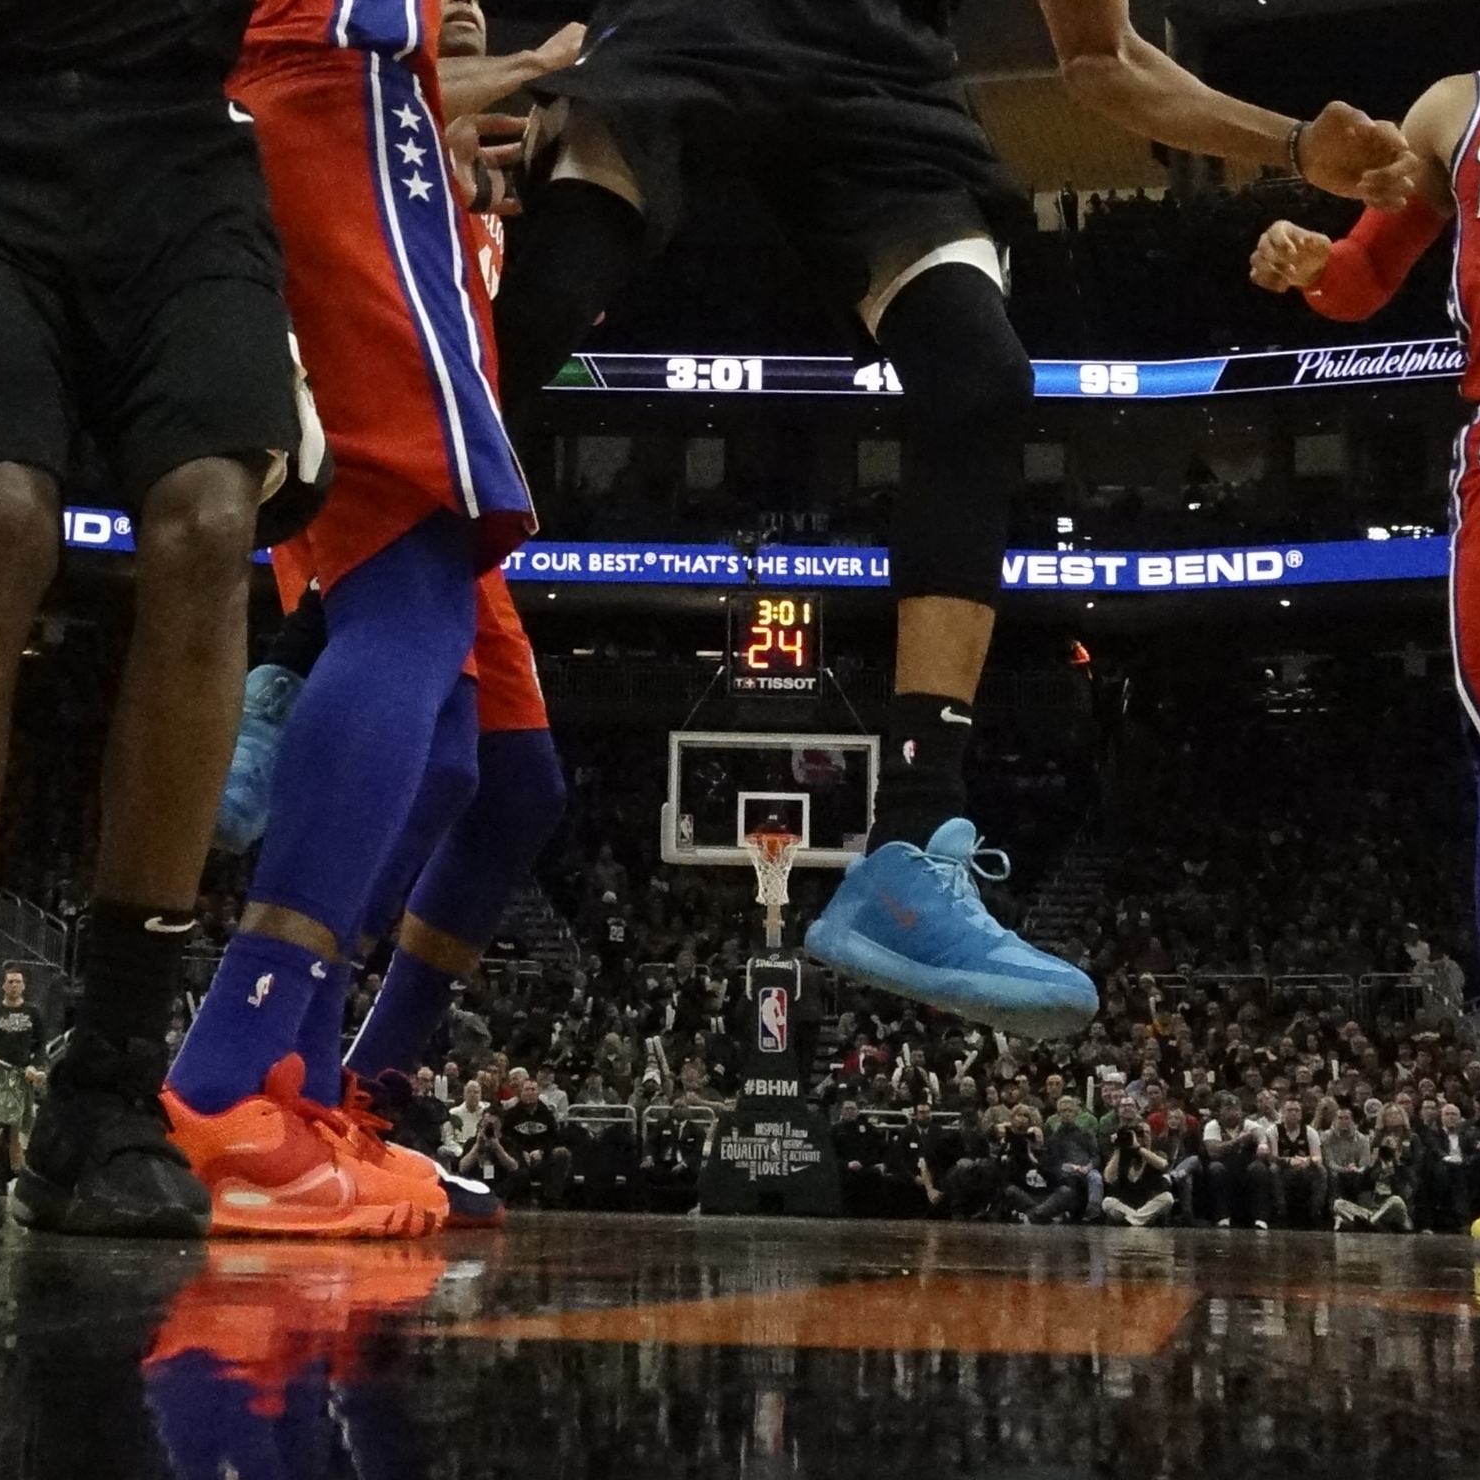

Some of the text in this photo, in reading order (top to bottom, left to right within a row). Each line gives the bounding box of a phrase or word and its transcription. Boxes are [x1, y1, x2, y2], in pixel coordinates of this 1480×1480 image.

[666, 342, 1466, 395] 3:01 95 Philadelphia
[531, 552, 582, 573] OUR
[659, 555, 739, 575] THAT'S
[794, 556, 864, 577] SILVER
[758, 599, 810, 626] 3:01
[747, 626, 803, 669] 24
[756, 677, 817, 690] TISSOT
[744, 1079, 799, 1098] #BHM
[720, 1142, 771, 1161] EQUALITY
